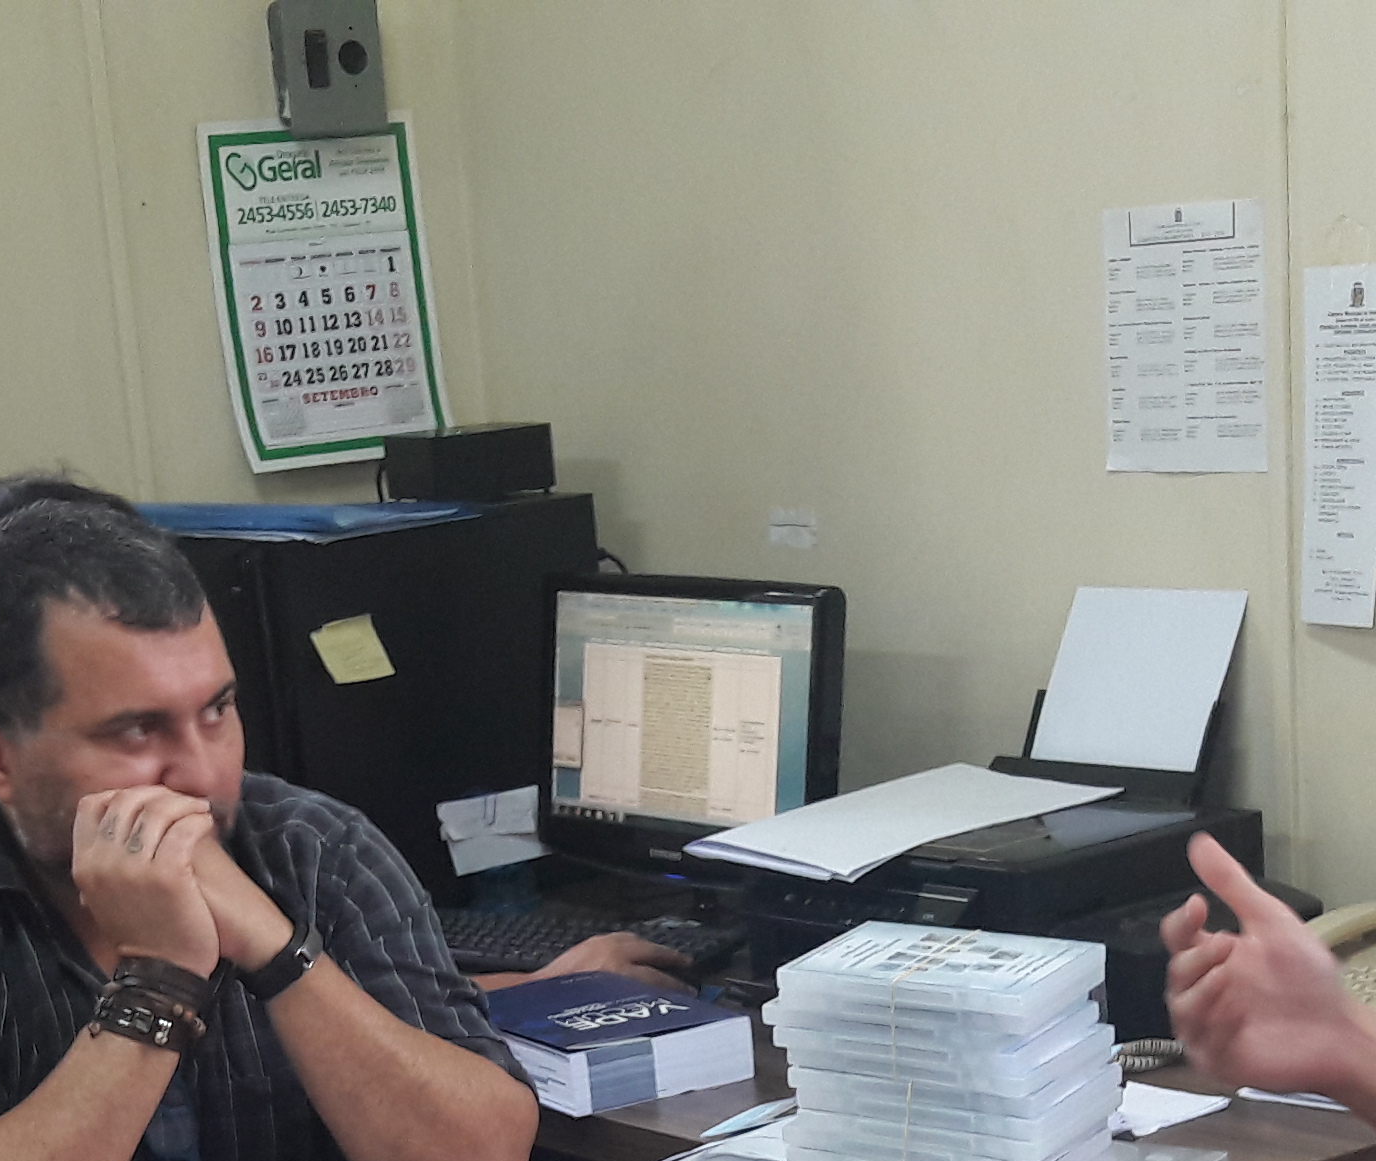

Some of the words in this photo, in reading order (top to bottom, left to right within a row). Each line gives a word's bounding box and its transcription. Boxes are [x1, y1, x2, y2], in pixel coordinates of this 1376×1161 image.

[258, 150, 322, 182] Geral
[237, 201, 314, 226] 2453-4556
[321, 195, 397, 219] 2453-7340
[387, 256, 396, 273] 1
[251, 295, 263, 312] 2
[275, 293, 286, 310] 3
[299, 290, 310, 307] 4
[321, 288, 332, 304] 5
[345, 286, 356, 302] 6
[365, 284, 376, 300] 7
[389, 282, 400, 298] 8
[255, 321, 267, 337] 9
[275, 318, 293, 335] 10
[299, 315, 316, 333] 11
[322, 313, 339, 331] 12
[344, 311, 362, 329] 13
[366, 309, 384, 326] 14
[390, 307, 407, 323] 15
[256, 347, 273, 364] 16
[278, 344, 296, 361] 17
[302, 341, 321, 359] 18
[325, 339, 343, 356] 19
[347, 337, 367, 353] 20
[370, 334, 389, 351] 21
[393, 332, 413, 348] 22
[282, 370, 303, 387] 24
[305, 367, 325, 385] 25
[329, 365, 348, 382] 26
[352, 362, 370, 379] 27
[374, 359, 394, 377] 28
[395, 357, 417, 374] 29
[301, 386, 379, 405] SETEMBRO
[572, 1003, 691, 1031] VADE
